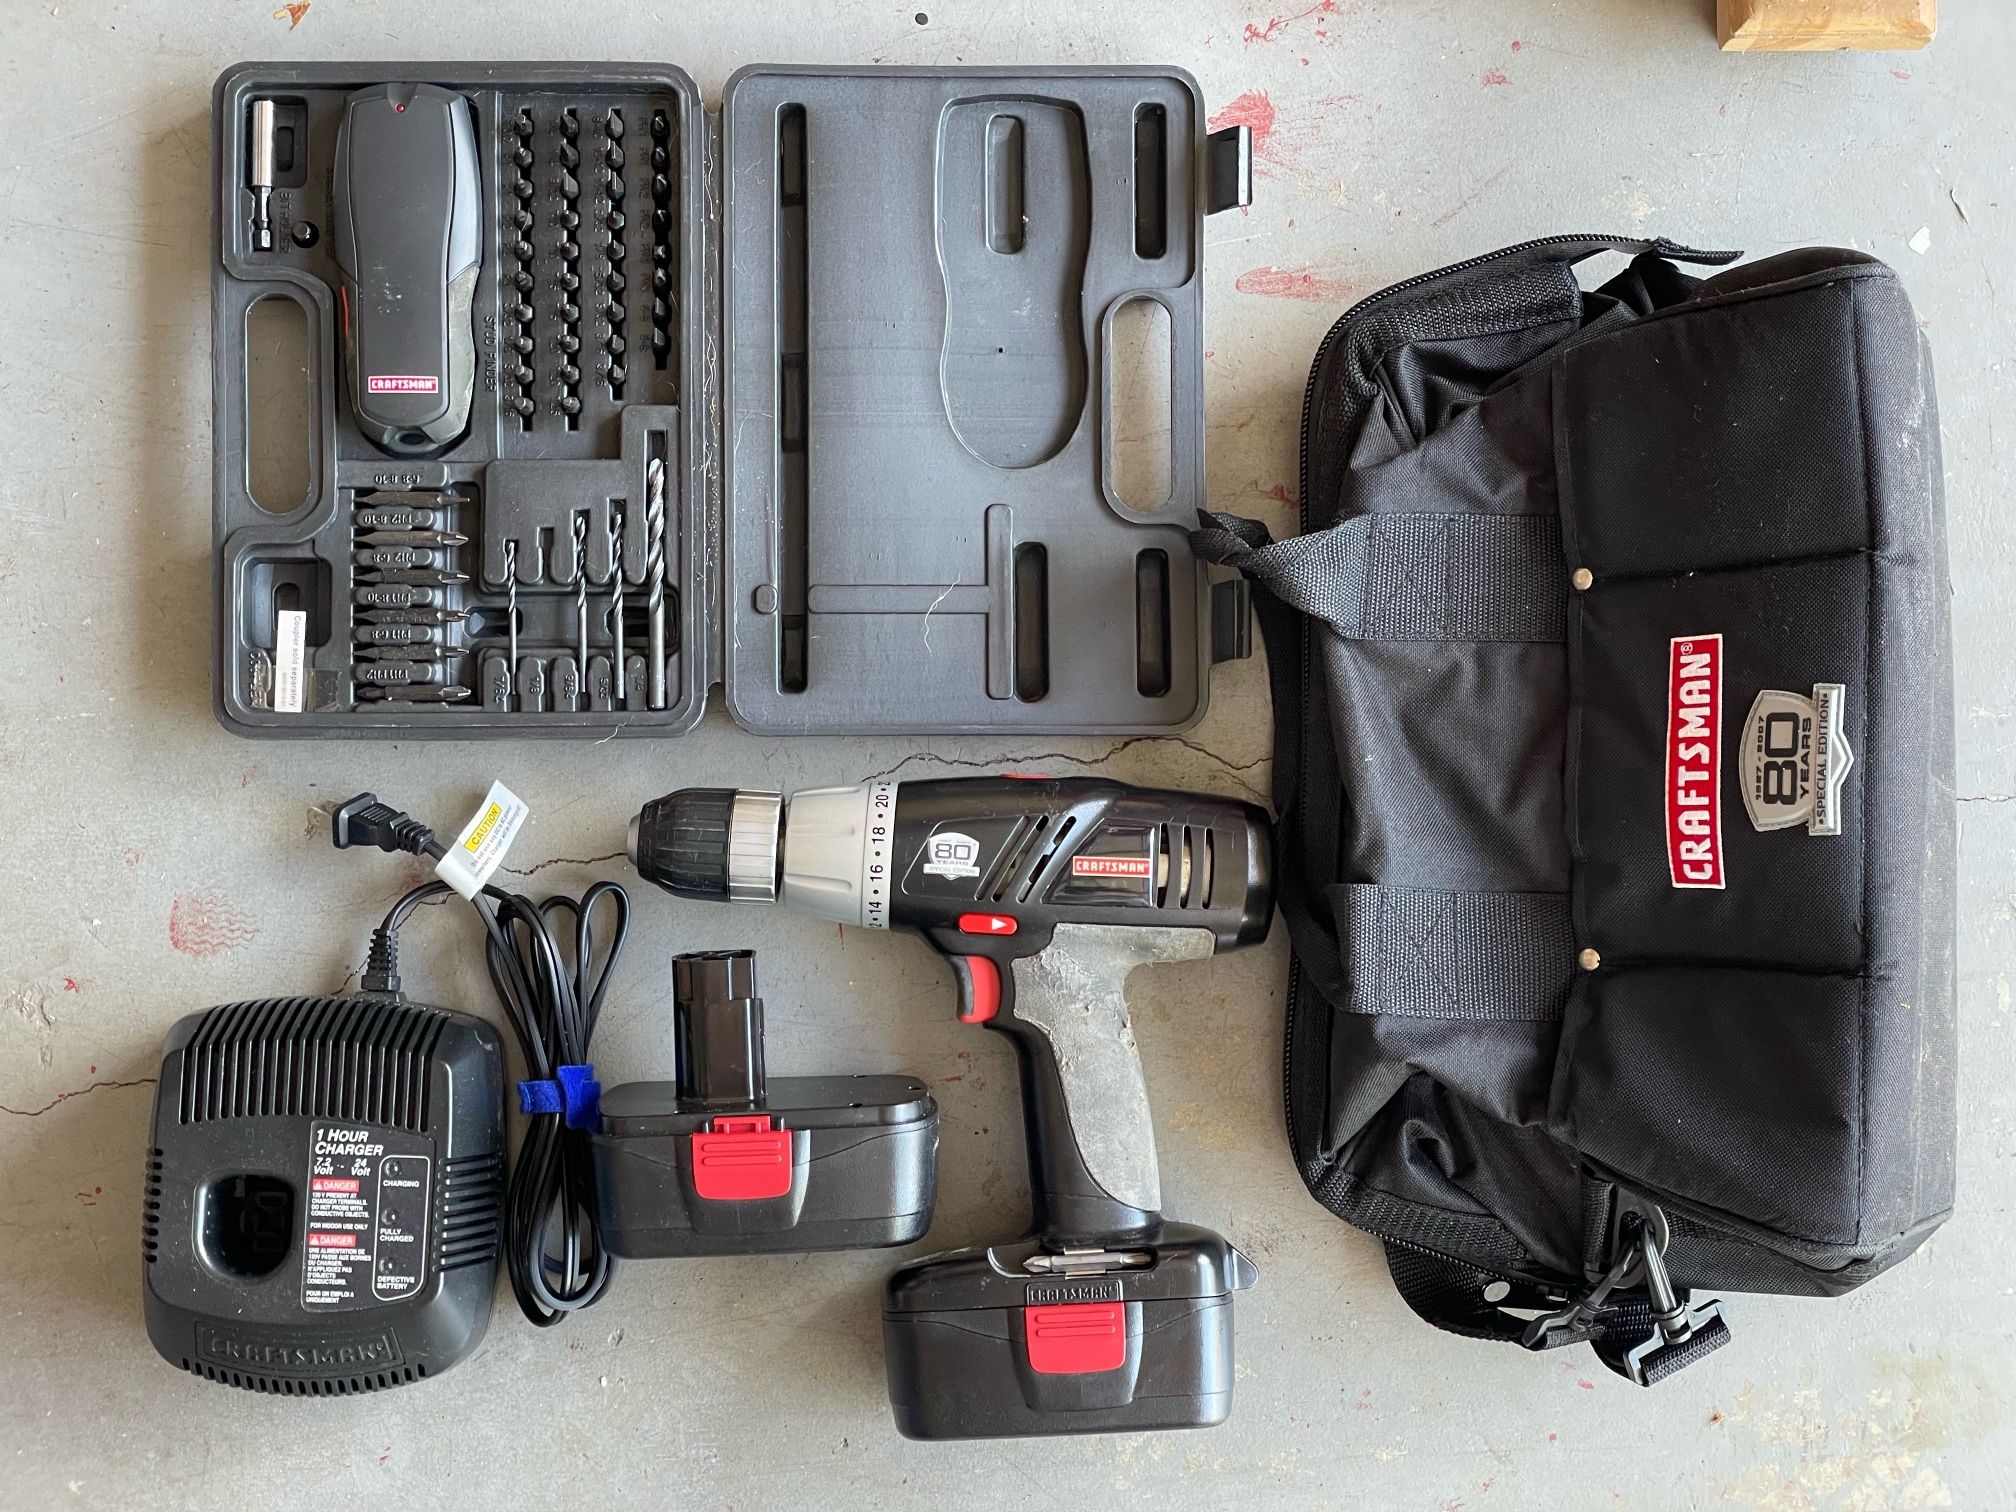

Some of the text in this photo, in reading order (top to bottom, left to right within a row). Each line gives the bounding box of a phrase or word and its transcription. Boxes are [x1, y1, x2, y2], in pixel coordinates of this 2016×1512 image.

[485, 316, 497, 393] STUD FINDER
[371, 380, 433, 390] CRAFTSMAN
[289, 616, 302, 707] Coupler sold separately
[1757, 716, 1765, 755] 2007
[1763, 712, 1800, 806] 80
[1800, 717, 1812, 799] YEARS
[1816, 698, 1830, 818] SPECIAL EDITION
[875, 794, 889, 808] 20
[471, 808, 499, 845] CAUTION
[872, 826, 886, 844] 18
[935, 843, 971, 860] 80
[870, 864, 884, 882] 16
[1076, 860, 1145, 873] CRAFTSMAN
[869, 901, 882, 914] 14
[317, 1129, 369, 1143] 1 HOUR
[315, 1142, 384, 1156] CHARGER
[316, 1157, 368, 1168] 7.2 24
[314, 1165, 371, 1176] Volt Volt
[323, 1181, 357, 1191] DANGER
[383, 1180, 420, 1188] CHARGING
[320, 1235, 353, 1245] DANGER
[379, 1235, 415, 1243] CHARGED
[377, 1276, 415, 1284] DEFECTIVE
[211, 1337, 376, 1364] CRAFTSMAN
